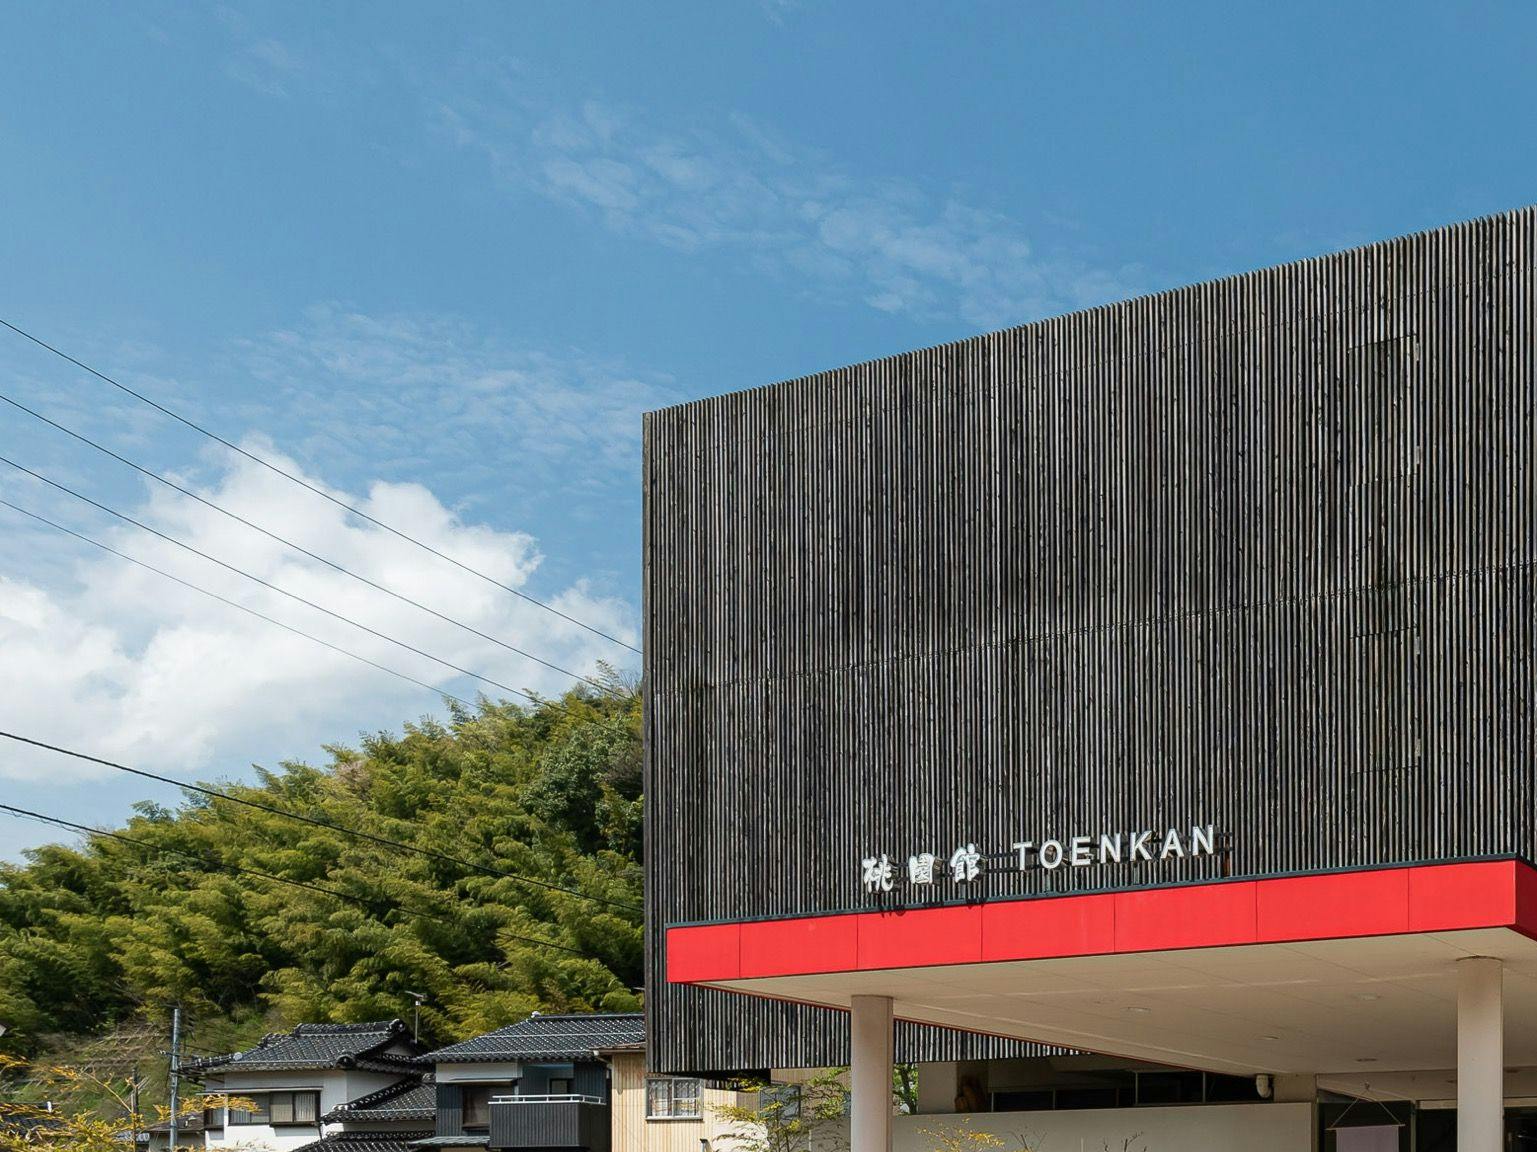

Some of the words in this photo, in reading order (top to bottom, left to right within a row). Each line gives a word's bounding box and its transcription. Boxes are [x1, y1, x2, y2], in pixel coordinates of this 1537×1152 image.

[861, 842, 981, 894] 桃園館
[1013, 824, 1215, 872] TOENKAN
